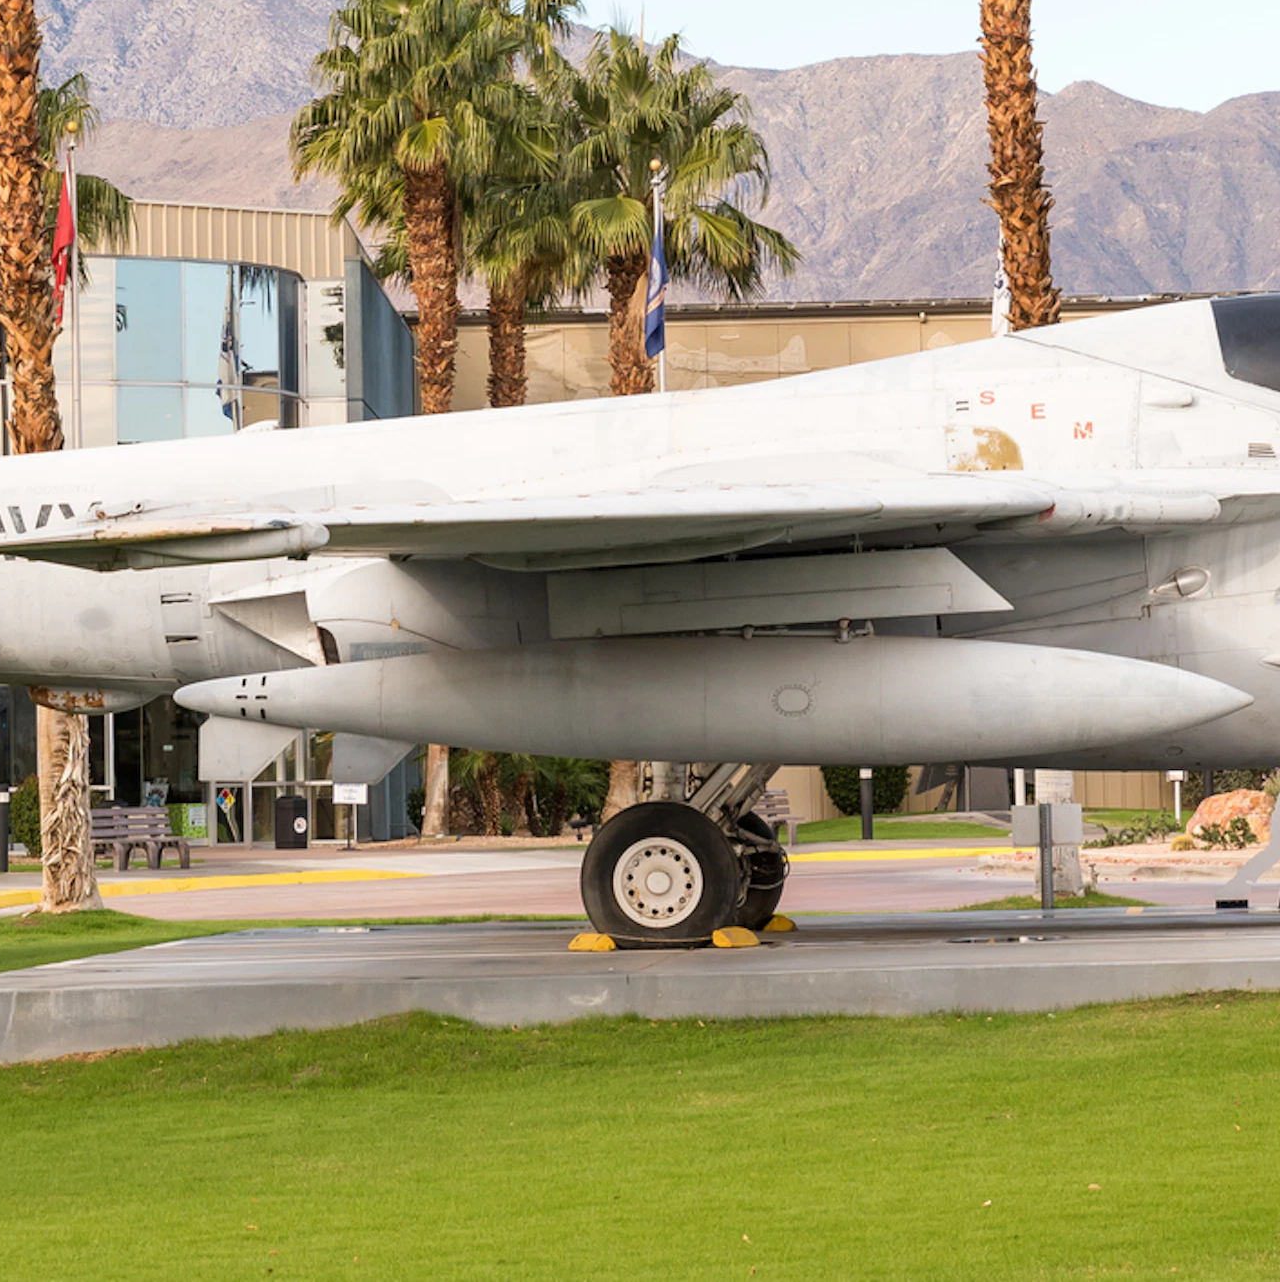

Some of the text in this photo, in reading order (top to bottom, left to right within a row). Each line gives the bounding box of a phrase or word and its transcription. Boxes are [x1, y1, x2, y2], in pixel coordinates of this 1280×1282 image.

[979, 390, 1093, 439] S E M
